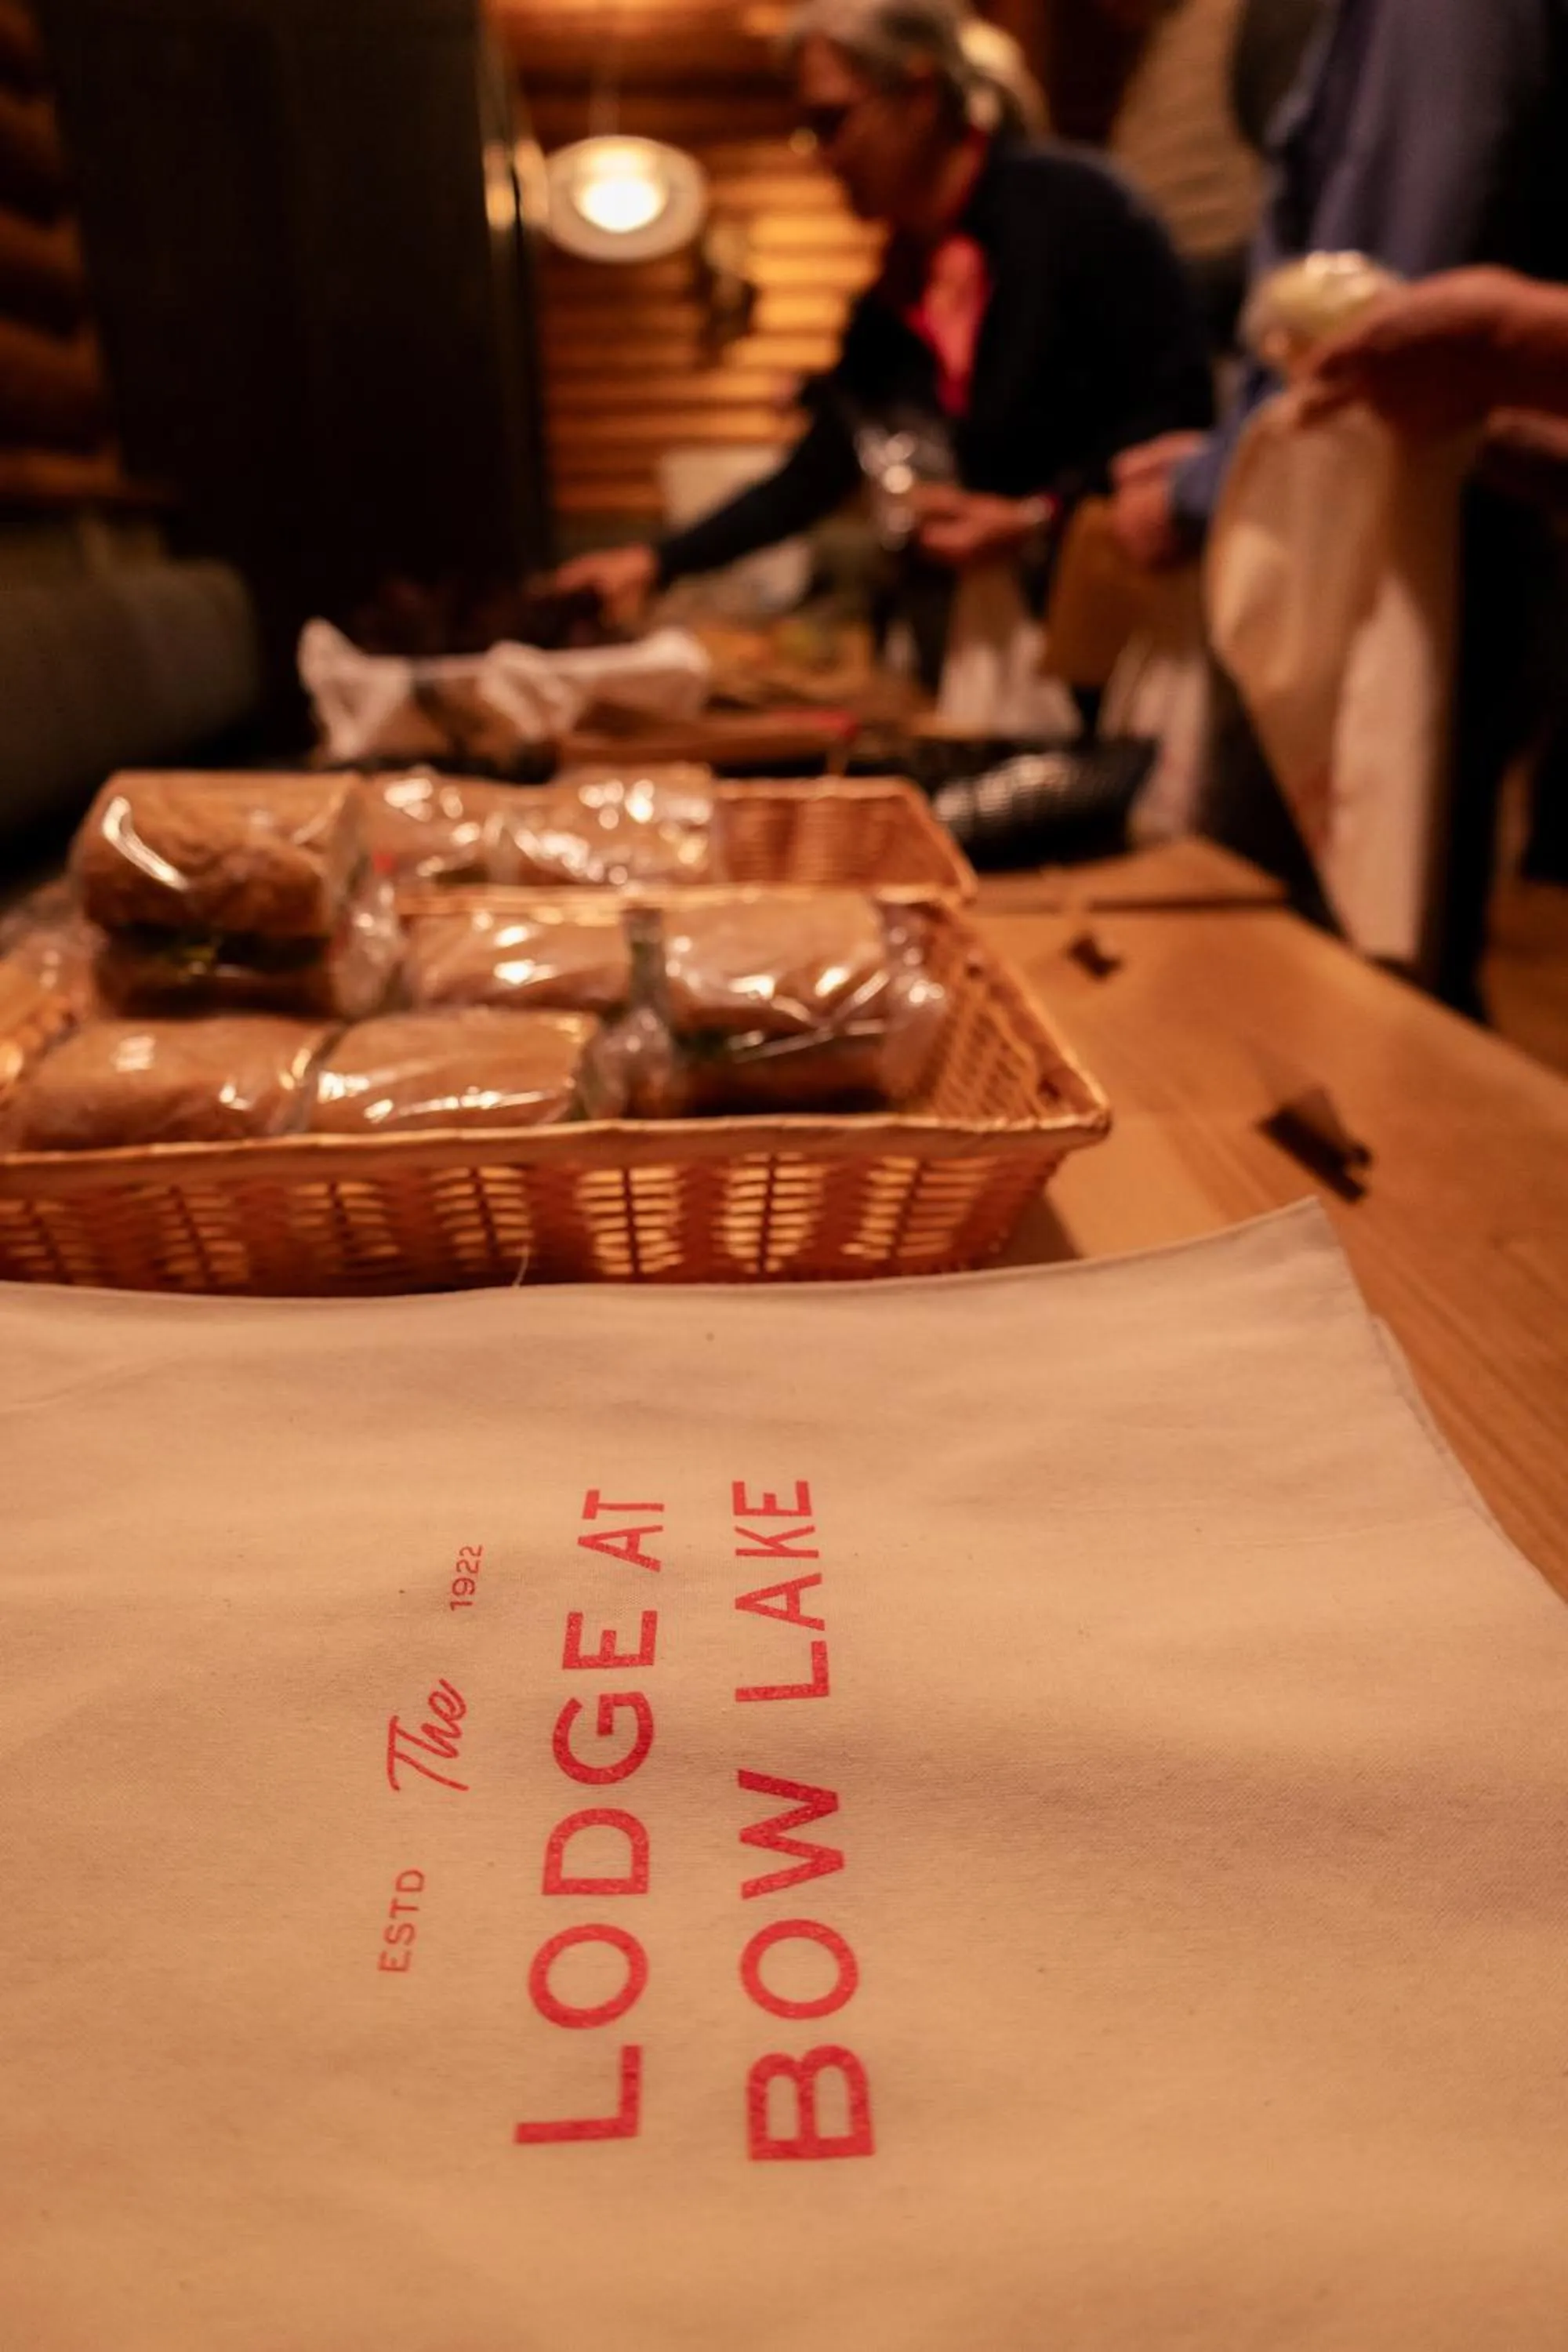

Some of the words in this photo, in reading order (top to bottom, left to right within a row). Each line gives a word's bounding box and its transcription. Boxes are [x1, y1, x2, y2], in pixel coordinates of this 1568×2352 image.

[449, 1545, 483, 1610] 1922
[577, 1489, 665, 1572] AT
[732, 1479, 830, 1703] LAKE
[386, 1679, 470, 1792] The
[379, 1869, 425, 1972] ESTD
[514, 1610, 659, 2146] LODGE
[737, 1768, 876, 2161] BOW
